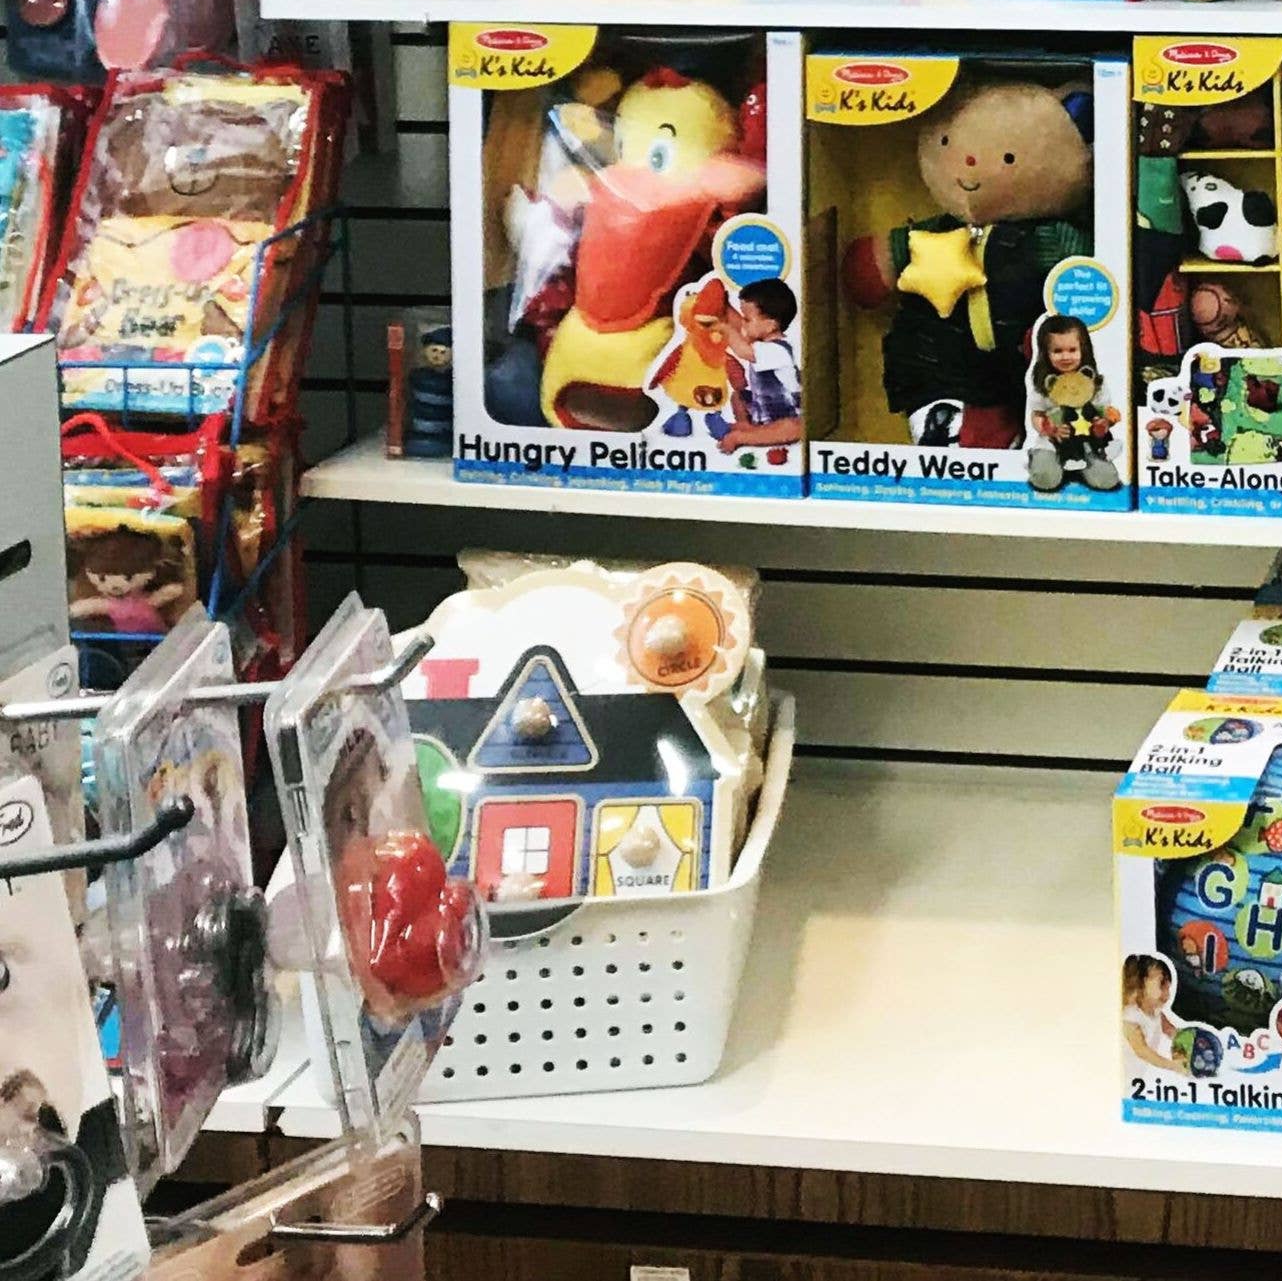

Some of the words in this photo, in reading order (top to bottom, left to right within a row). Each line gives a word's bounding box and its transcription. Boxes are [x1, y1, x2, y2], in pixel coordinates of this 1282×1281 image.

[480, 55, 506, 77] K's
[511, 56, 558, 78] Kids
[1167, 70, 1193, 93] K's
[1198, 70, 1244, 94] Kids
[840, 89, 866, 111] K's
[871, 89, 916, 112] Kids
[459, 433, 576, 472] Hungry
[590, 441, 706, 471] Pelican
[818, 450, 907, 483] Teddy
[919, 454, 999, 481] Wear
[1231, 647, 1281, 657] 2-in-1
[1222, 664, 1262, 673] Ball
[1147, 754, 1224, 768] Talking
[1152, 744, 1205, 755] 2-in-1
[1140, 763, 1183, 774] Ball
[1145, 826, 1169, 847] K's
[1172, 828, 1213, 849] Kids
[617, 875, 670, 888] SQUARE
[1197, 862, 1236, 910] G
[1227, 1034, 1241, 1050] A
[1131, 1078, 1197, 1104] 2-in-1
